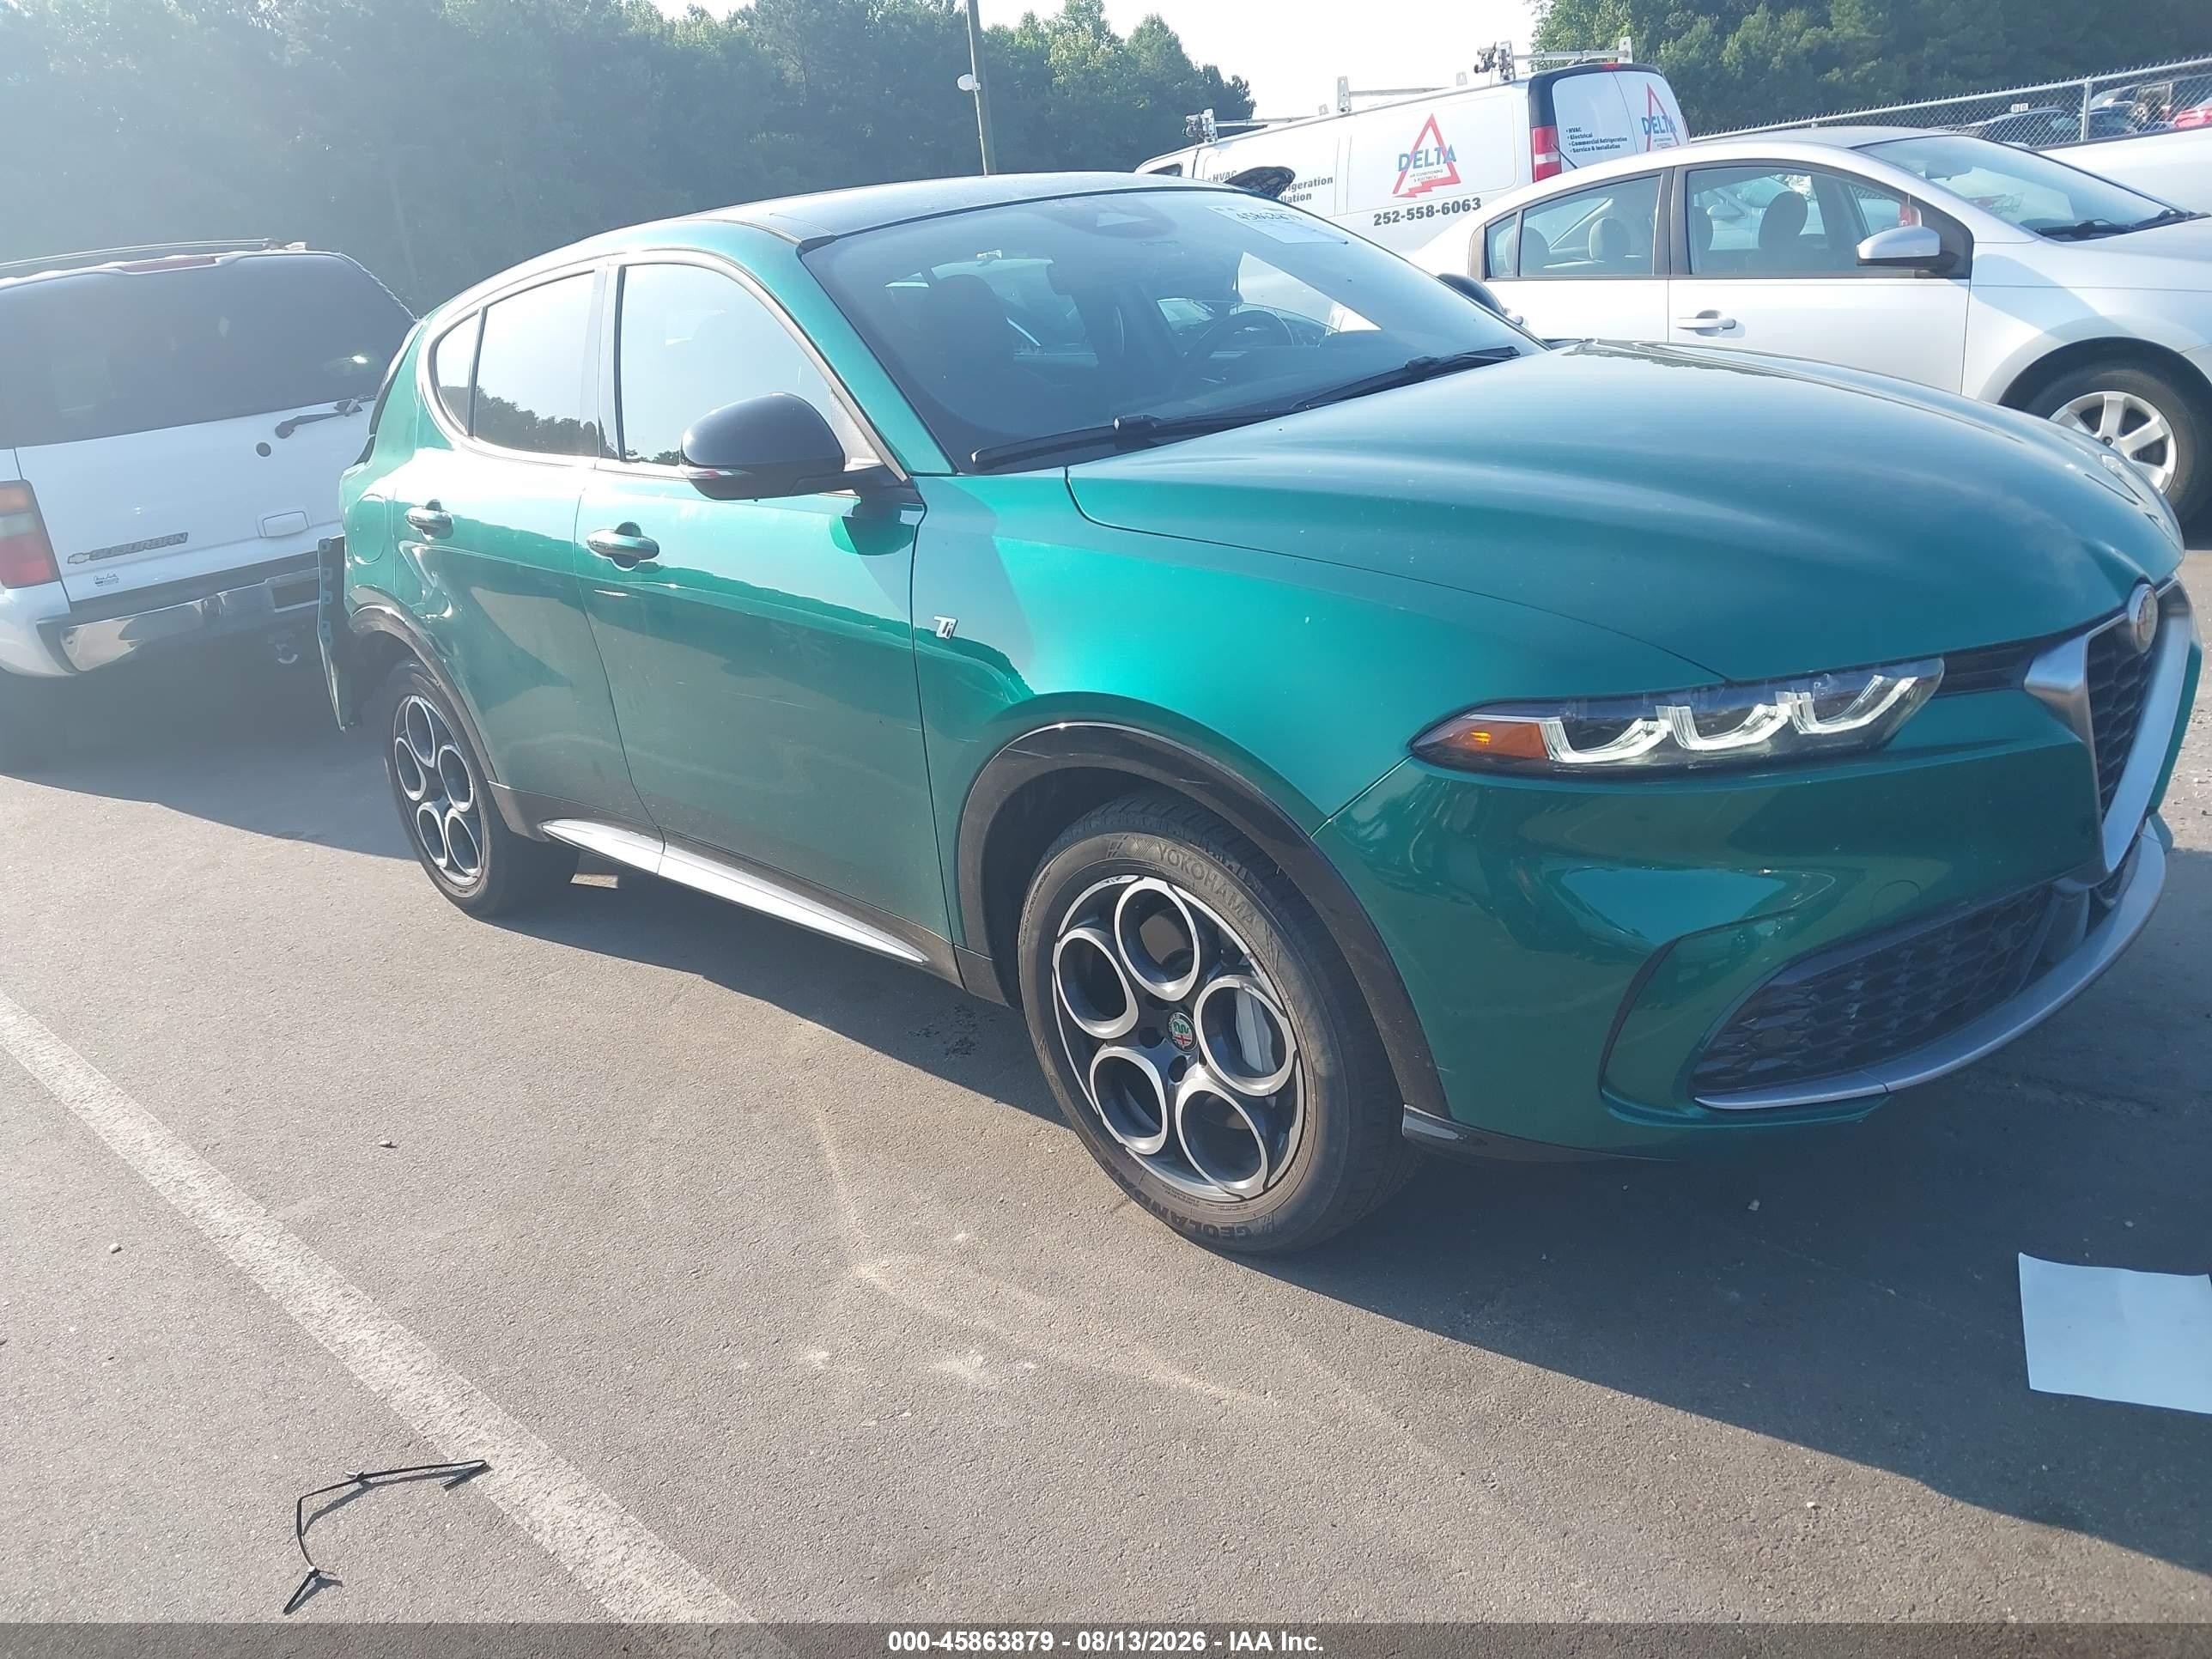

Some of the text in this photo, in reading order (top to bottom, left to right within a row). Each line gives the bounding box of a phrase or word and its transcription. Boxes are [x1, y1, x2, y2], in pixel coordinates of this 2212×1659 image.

[1641, 114, 1677, 136] DELTA
[1571, 138, 1599, 147] Commercial
[1398, 143, 1457, 173] DELTA
[1374, 197, 1482, 227] 252-558-6063
[89, 532, 188, 562] SUBURBAN
[1156, 842, 1261, 930] YOKOHAMA
